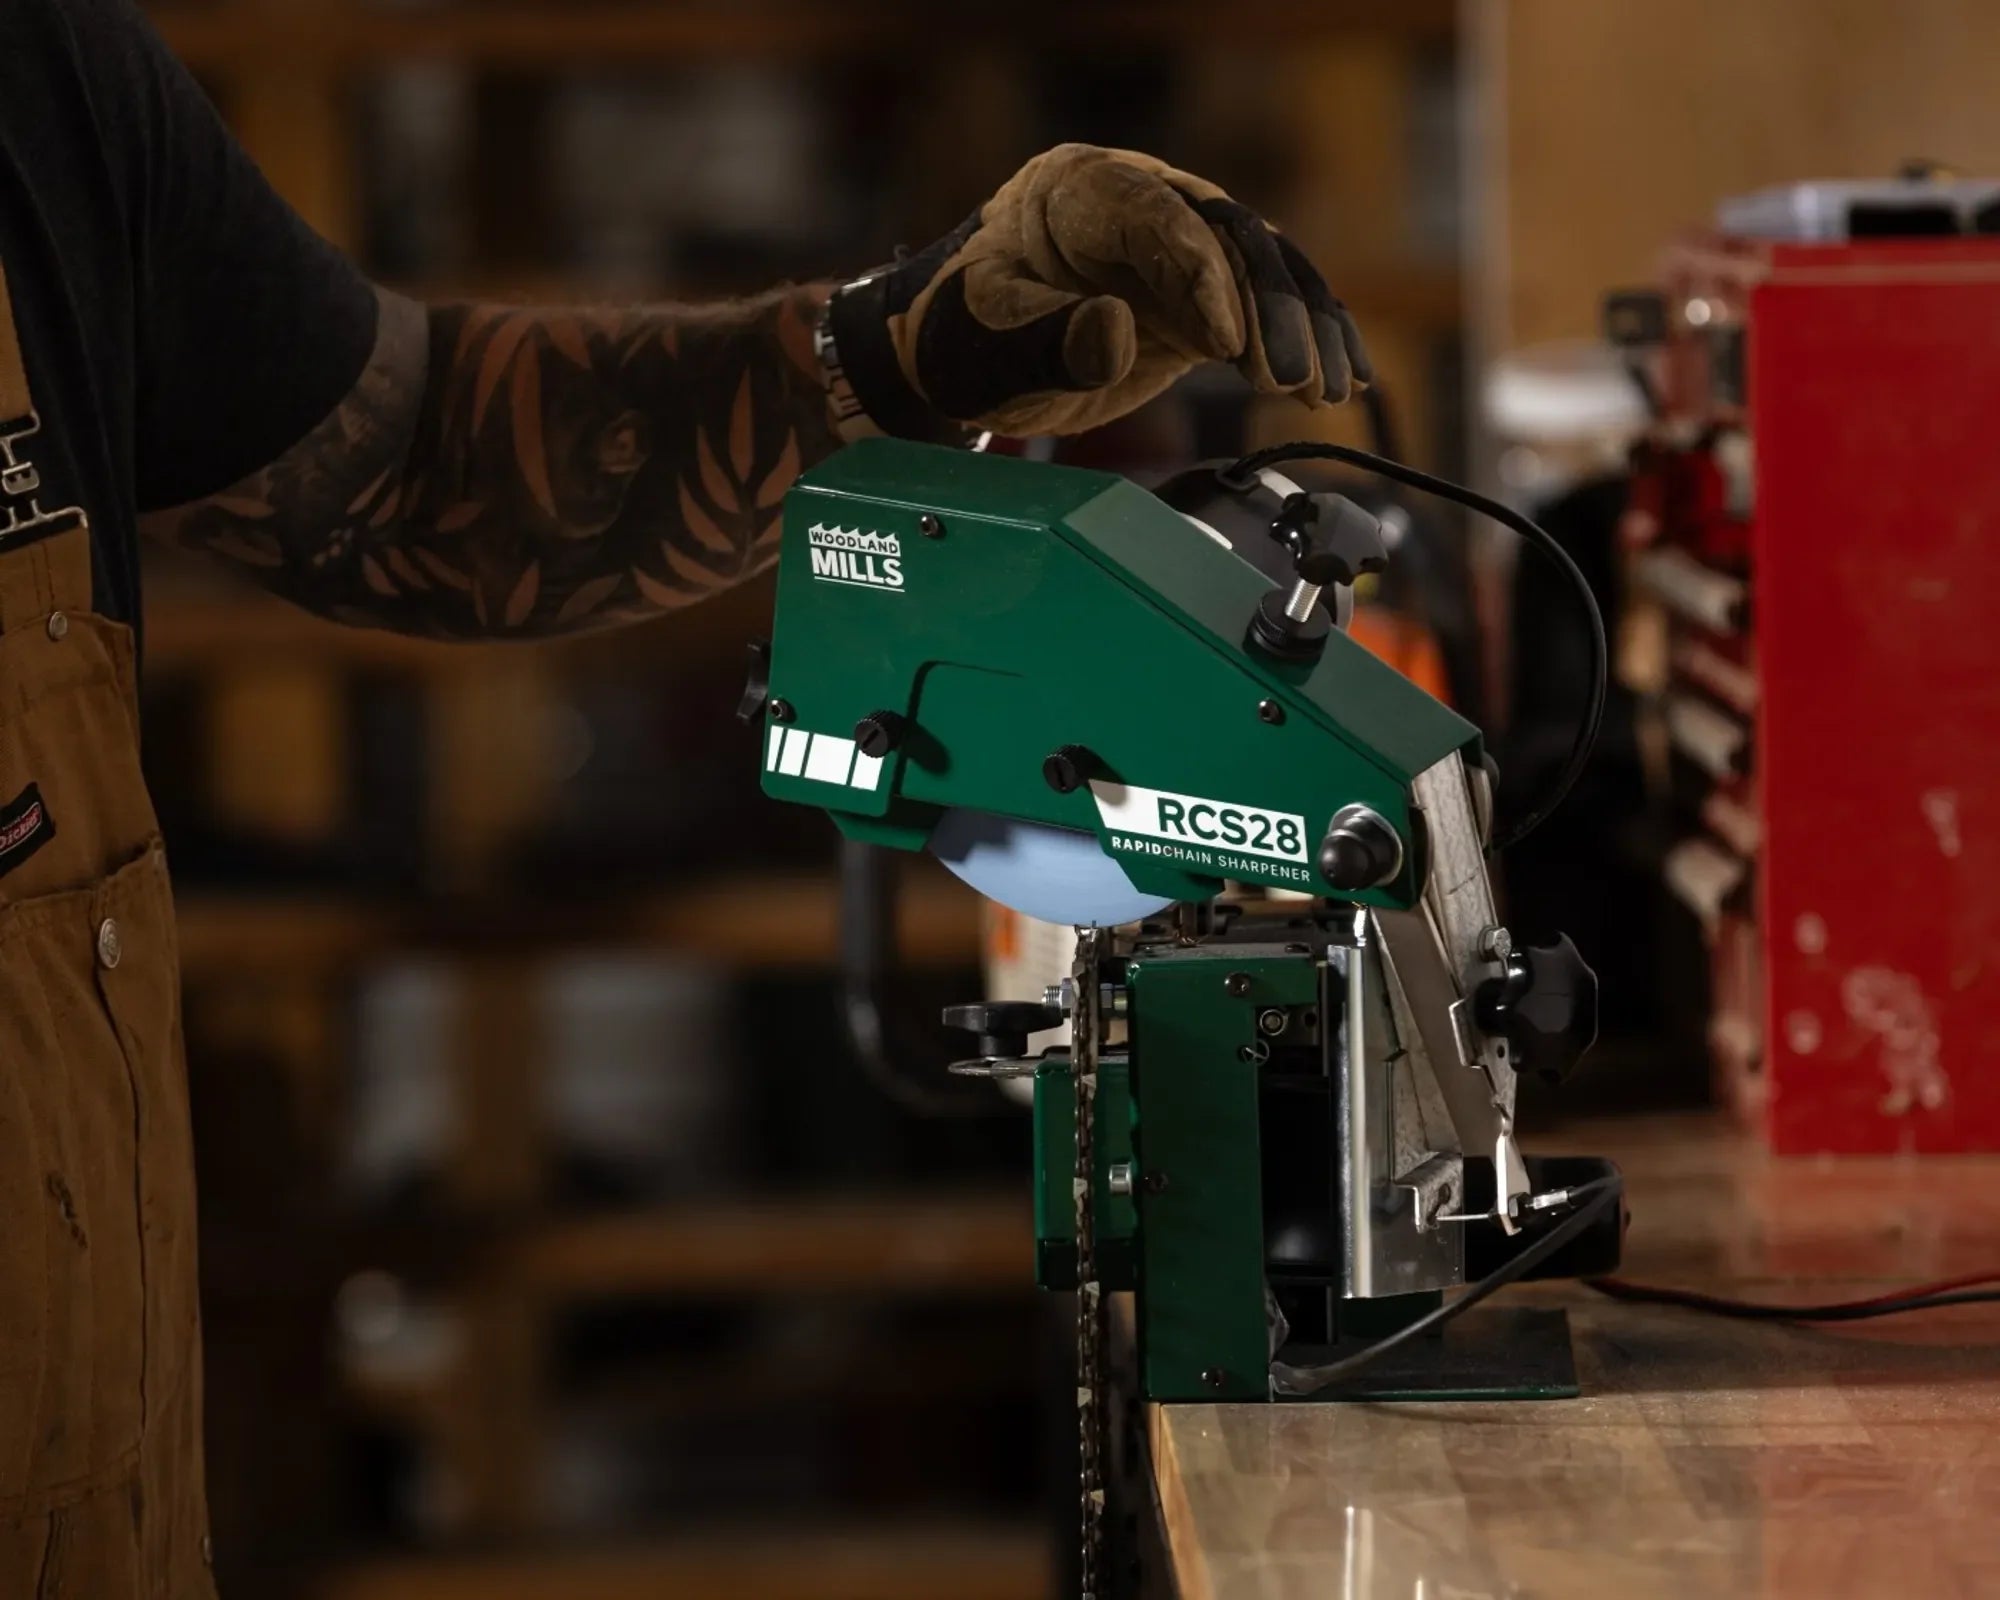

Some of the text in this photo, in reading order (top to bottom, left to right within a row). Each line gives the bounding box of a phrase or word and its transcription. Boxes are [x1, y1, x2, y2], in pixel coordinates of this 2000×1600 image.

[810, 531, 899, 554] WOODLAND
[810, 547, 905, 587] MILLS
[1157, 797, 1302, 856] RCS28
[1111, 836, 1311, 883] RAPIDCHAIN SHARPENER
